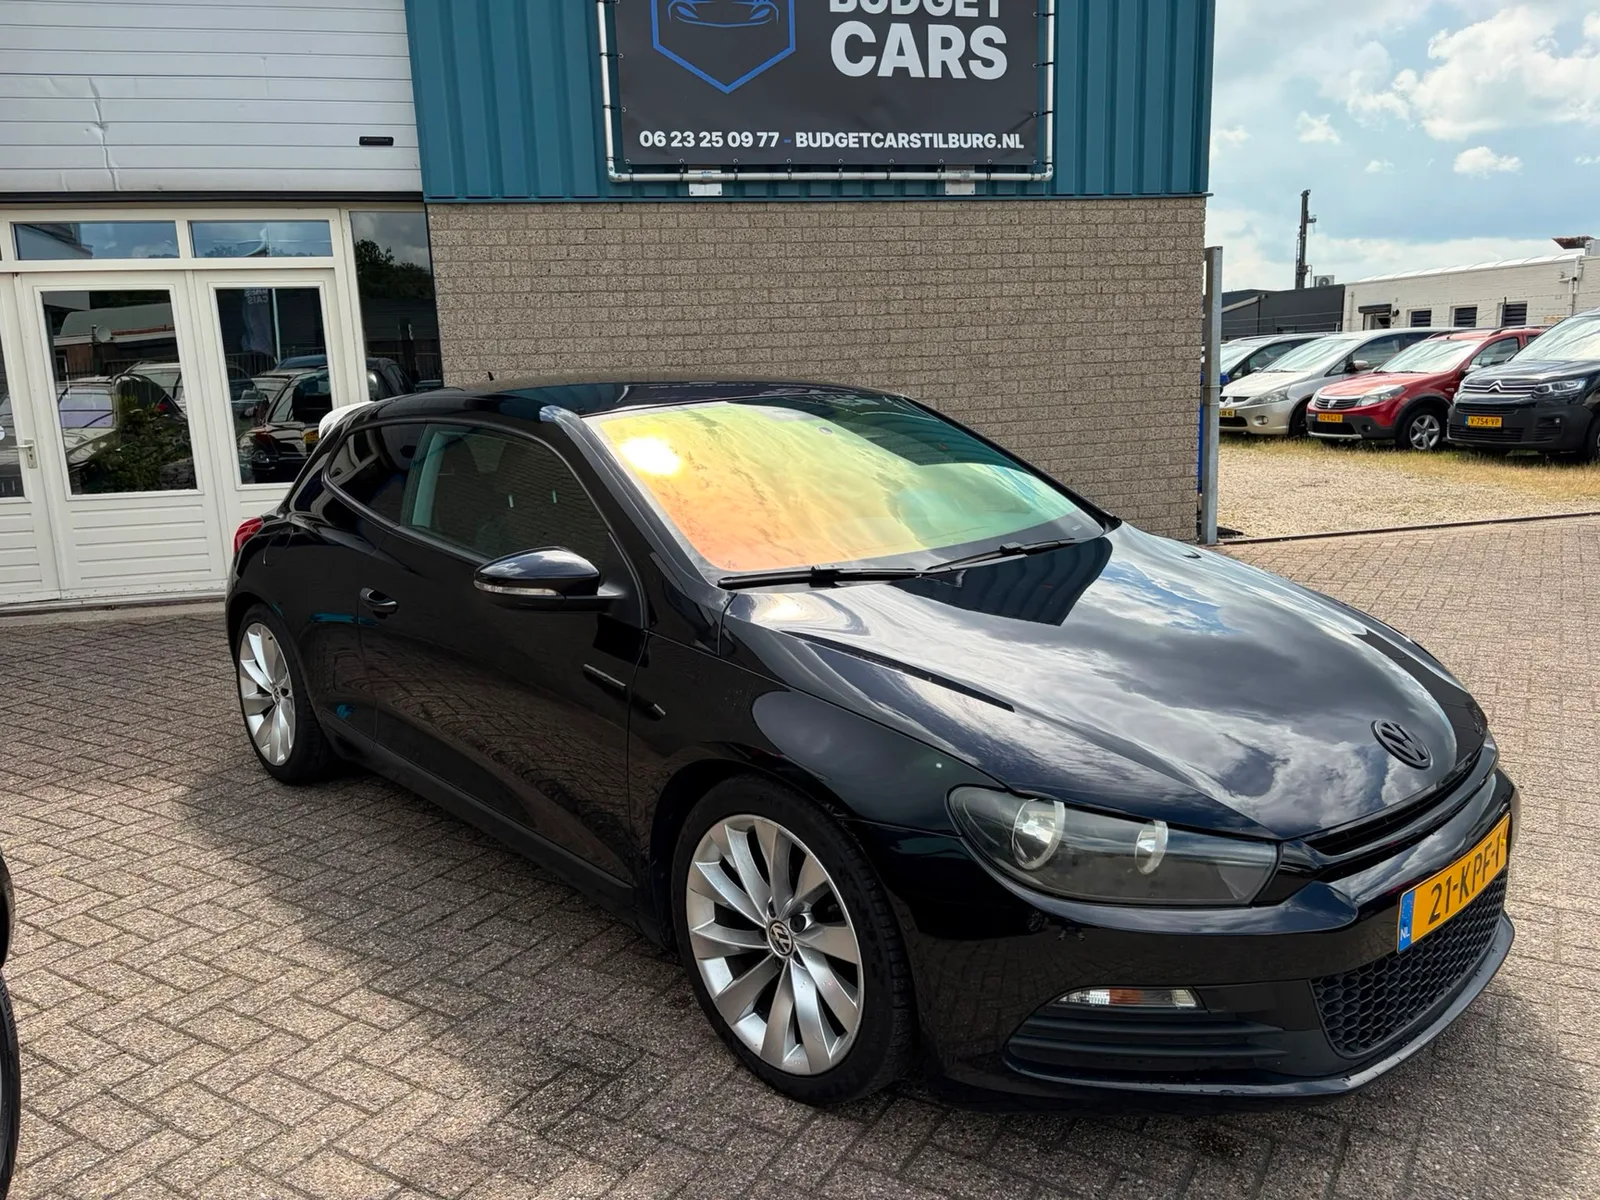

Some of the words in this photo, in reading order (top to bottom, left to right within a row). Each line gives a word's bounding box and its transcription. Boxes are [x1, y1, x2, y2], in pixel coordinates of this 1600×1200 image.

[830, 20, 1008, 80] CARS
[638, 130, 667, 148] 06
[669, 131, 696, 148] 23
[698, 131, 724, 148] 25
[727, 131, 754, 148] 09
[756, 131, 780, 148] 77
[795, 131, 1024, 149] BUDGETCARSTILBURG.NL
[1427, 831, 1502, 926] 21-KPF-1
[1400, 926, 1410, 941] NL
